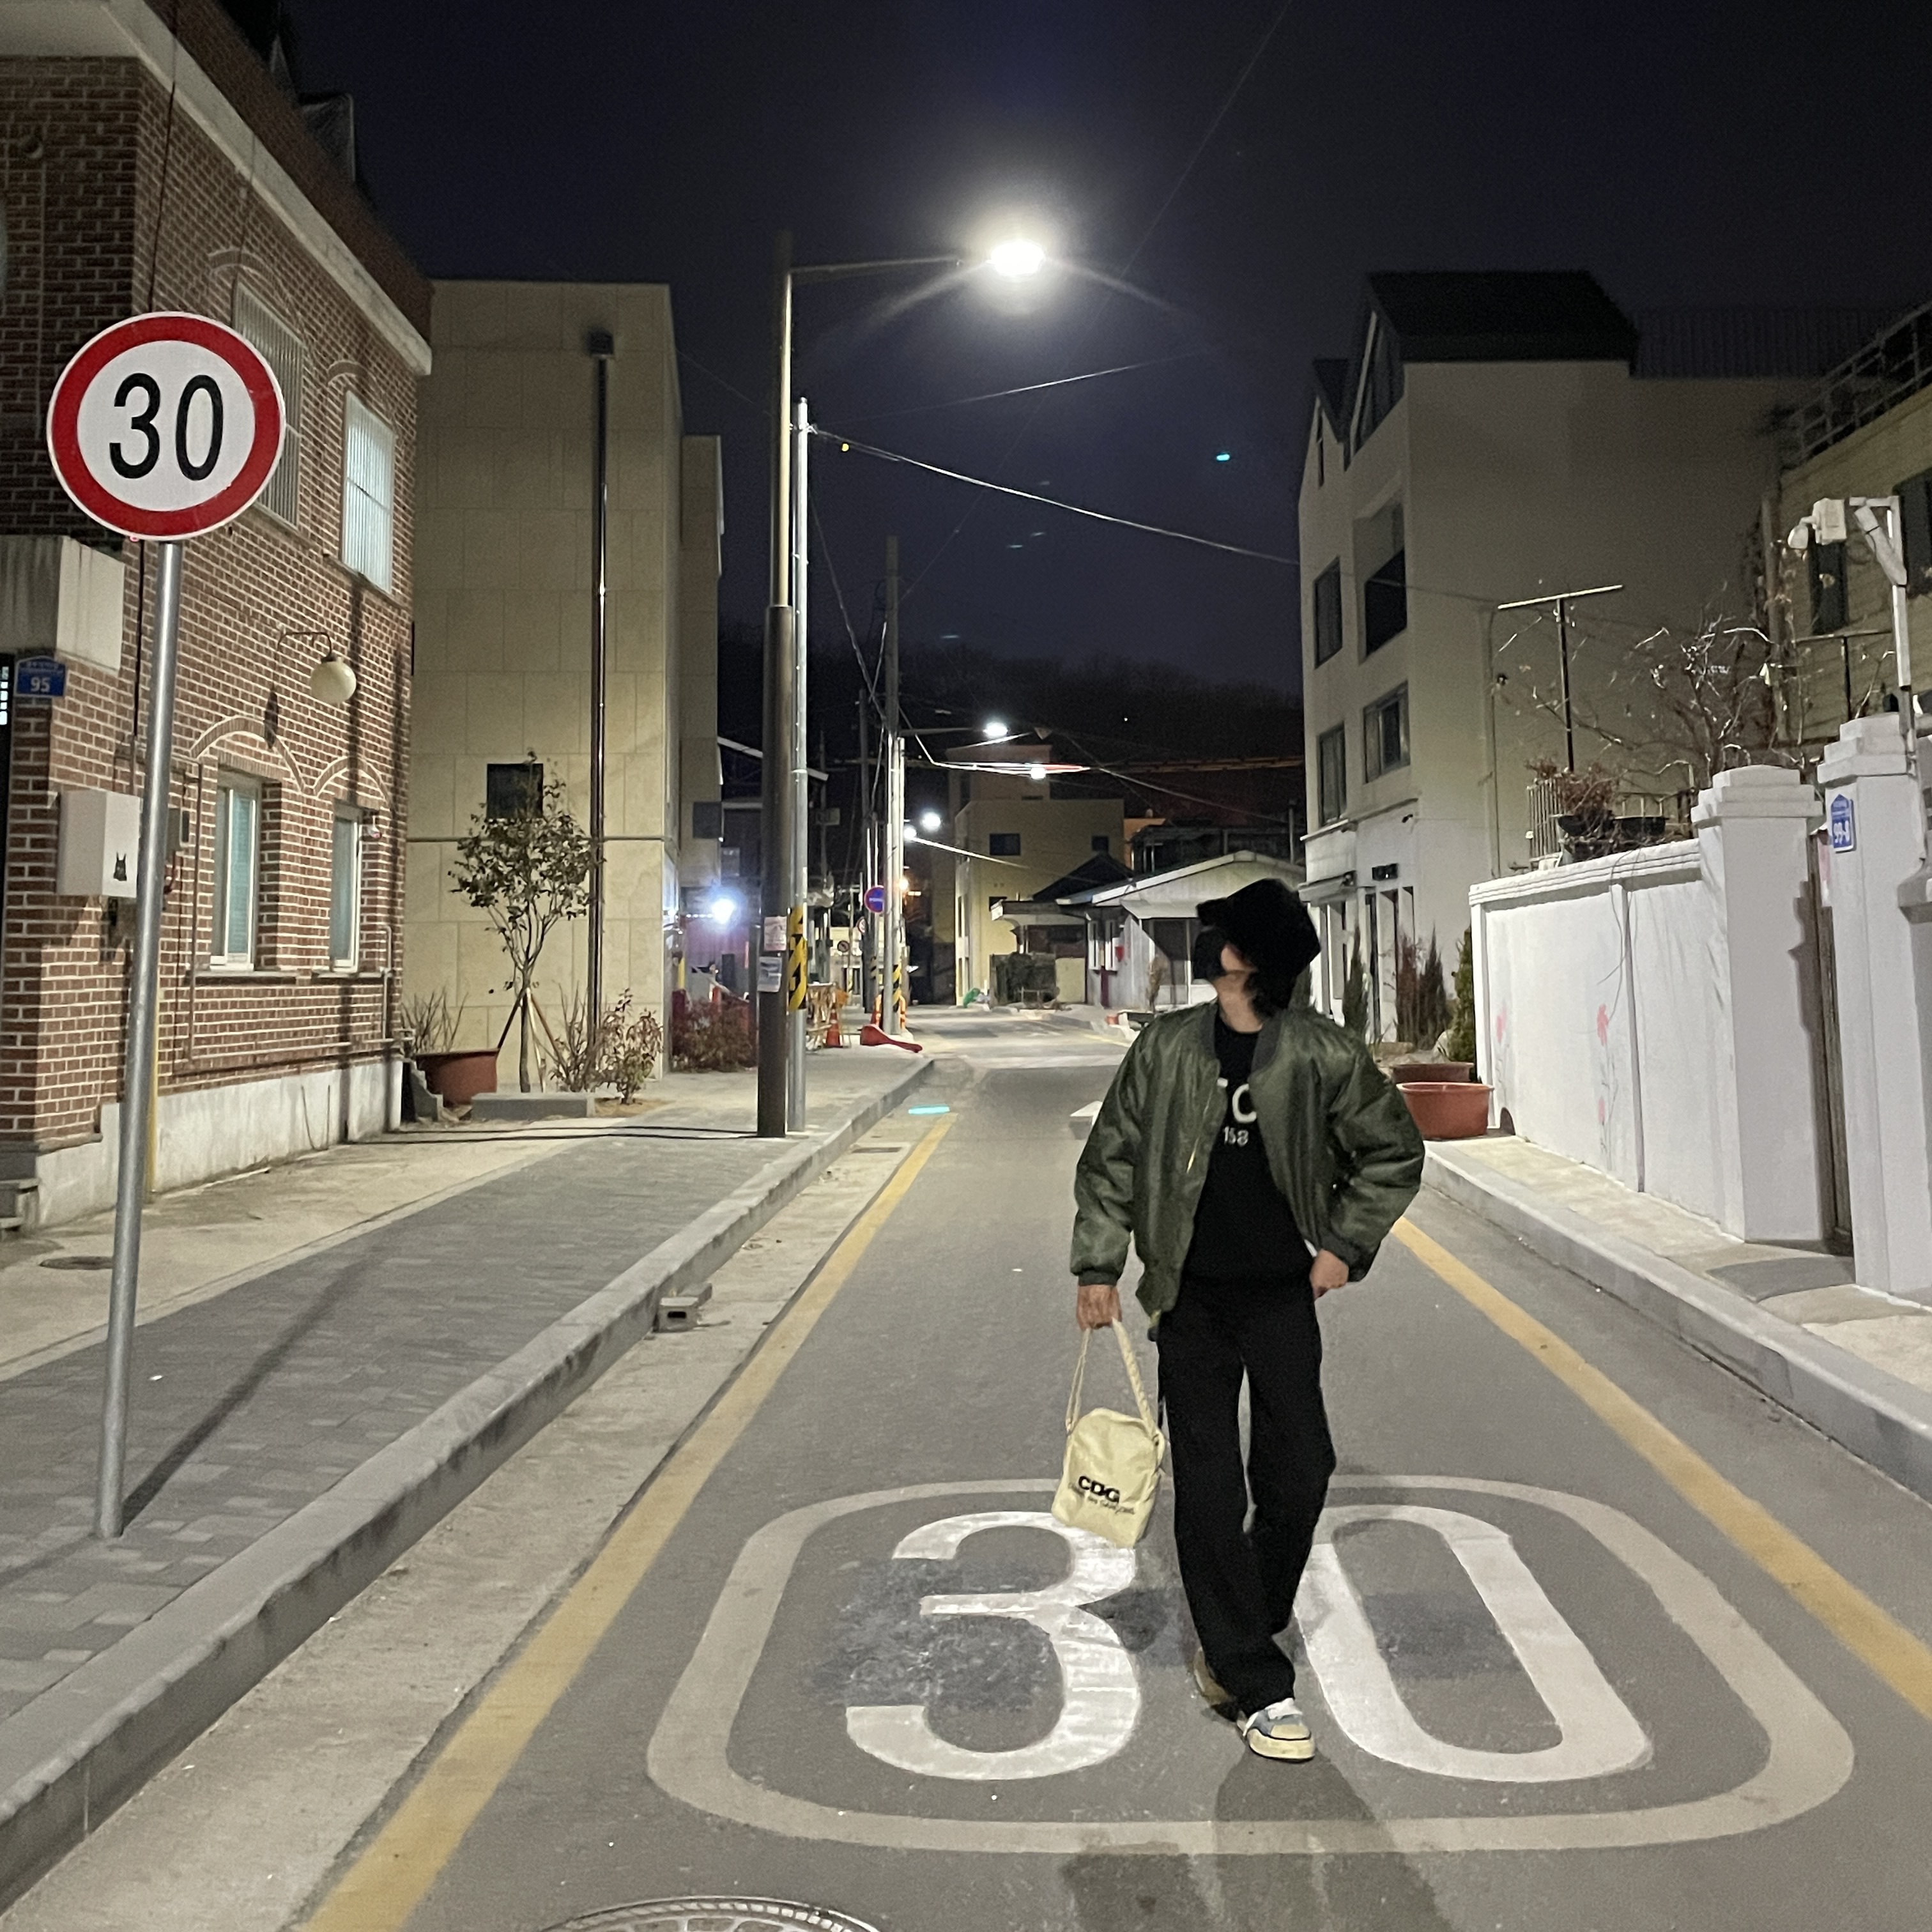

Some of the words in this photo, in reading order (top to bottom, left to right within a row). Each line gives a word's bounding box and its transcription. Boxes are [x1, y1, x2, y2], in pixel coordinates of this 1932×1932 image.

[109, 373, 223, 480] 30
[30, 677, 50, 692] 95
[1078, 1476, 1120, 1503] CDG
[846, 1505, 1653, 1782] 30
